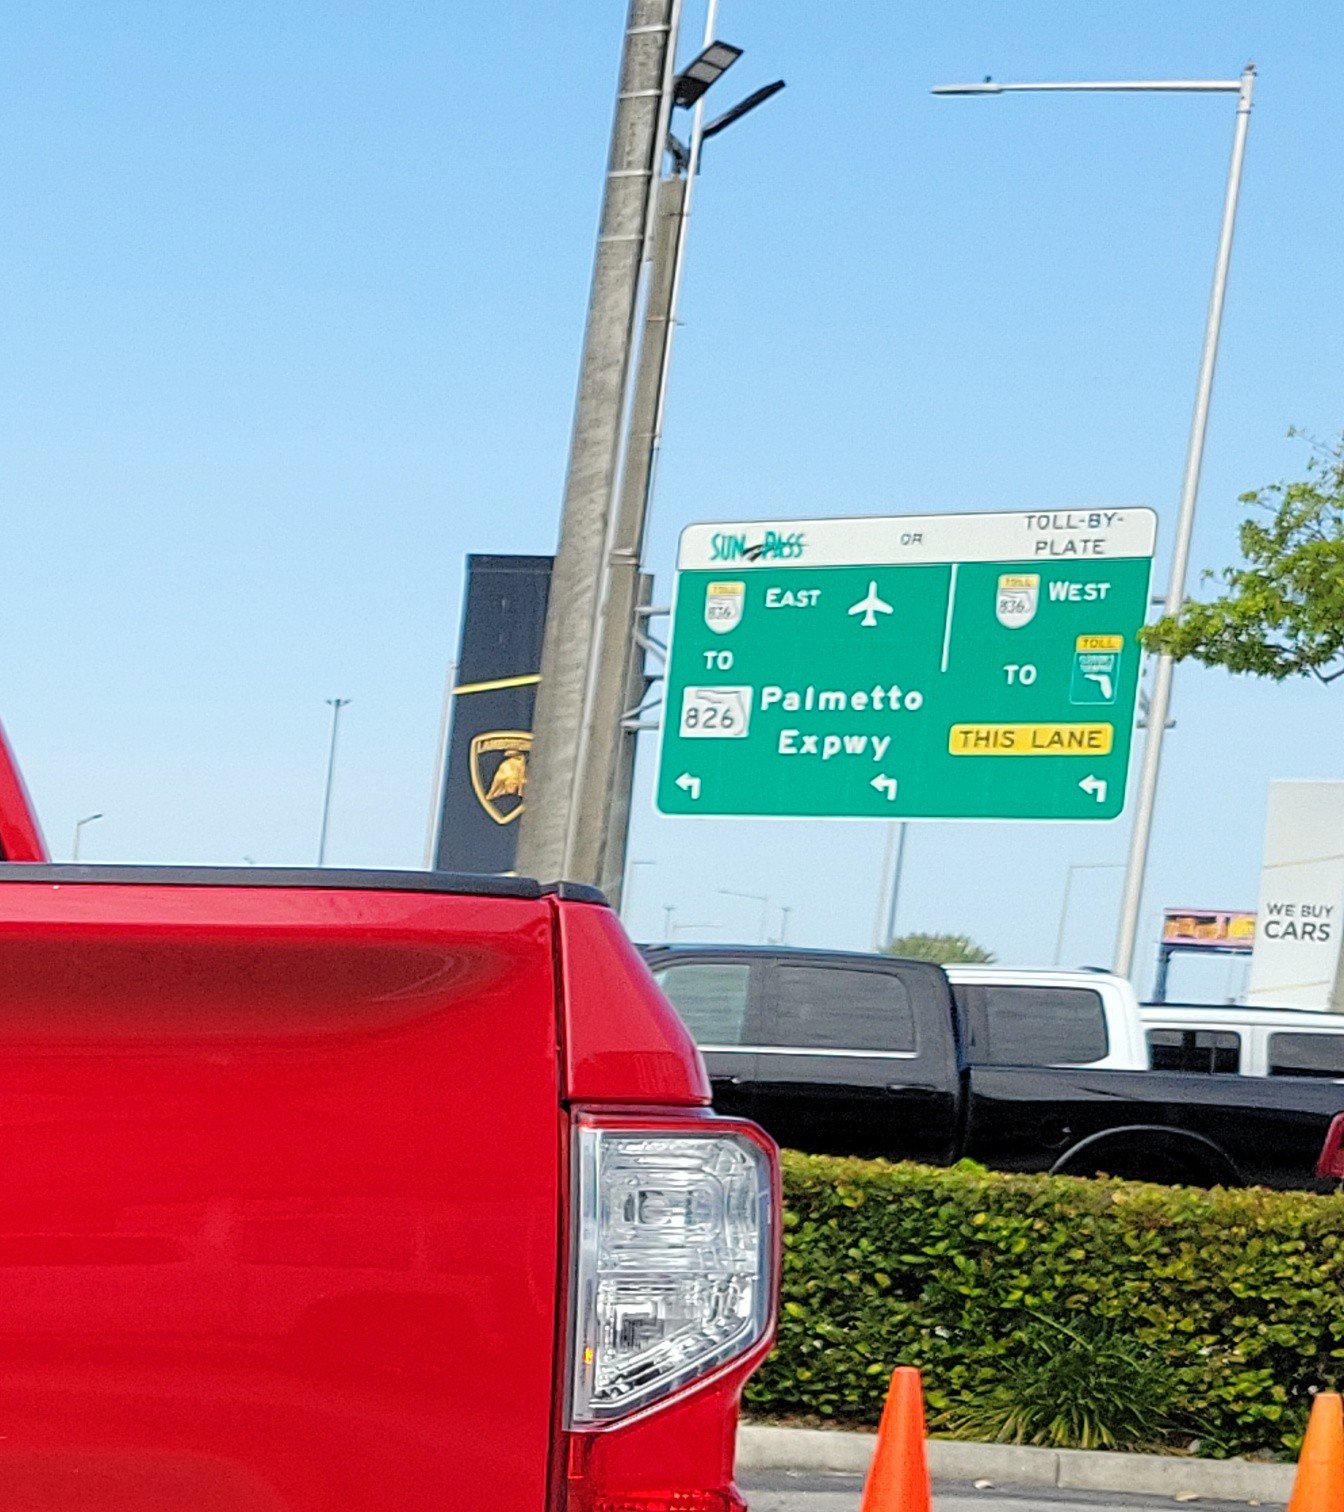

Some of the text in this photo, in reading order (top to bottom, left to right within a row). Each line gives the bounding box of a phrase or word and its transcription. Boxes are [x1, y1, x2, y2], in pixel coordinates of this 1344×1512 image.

[1025, 512, 1124, 530] TOLL-BY-
[900, 533, 923, 546] OR
[1035, 539, 1106, 556] PLATE
[765, 587, 822, 608] EAST
[1049, 581, 1111, 602] WEST
[1083, 638, 1116, 648] TOLL
[703, 650, 733, 670] TO
[1003, 664, 1037, 685] TO
[761, 685, 924, 711] Palmetto
[685, 707, 734, 728] 826
[778, 729, 891, 761] Expwy
[959, 730, 1103, 748] THIS LANE
[1266, 902, 1334, 918] WE BUY
[1264, 920, 1332, 941] CARS
